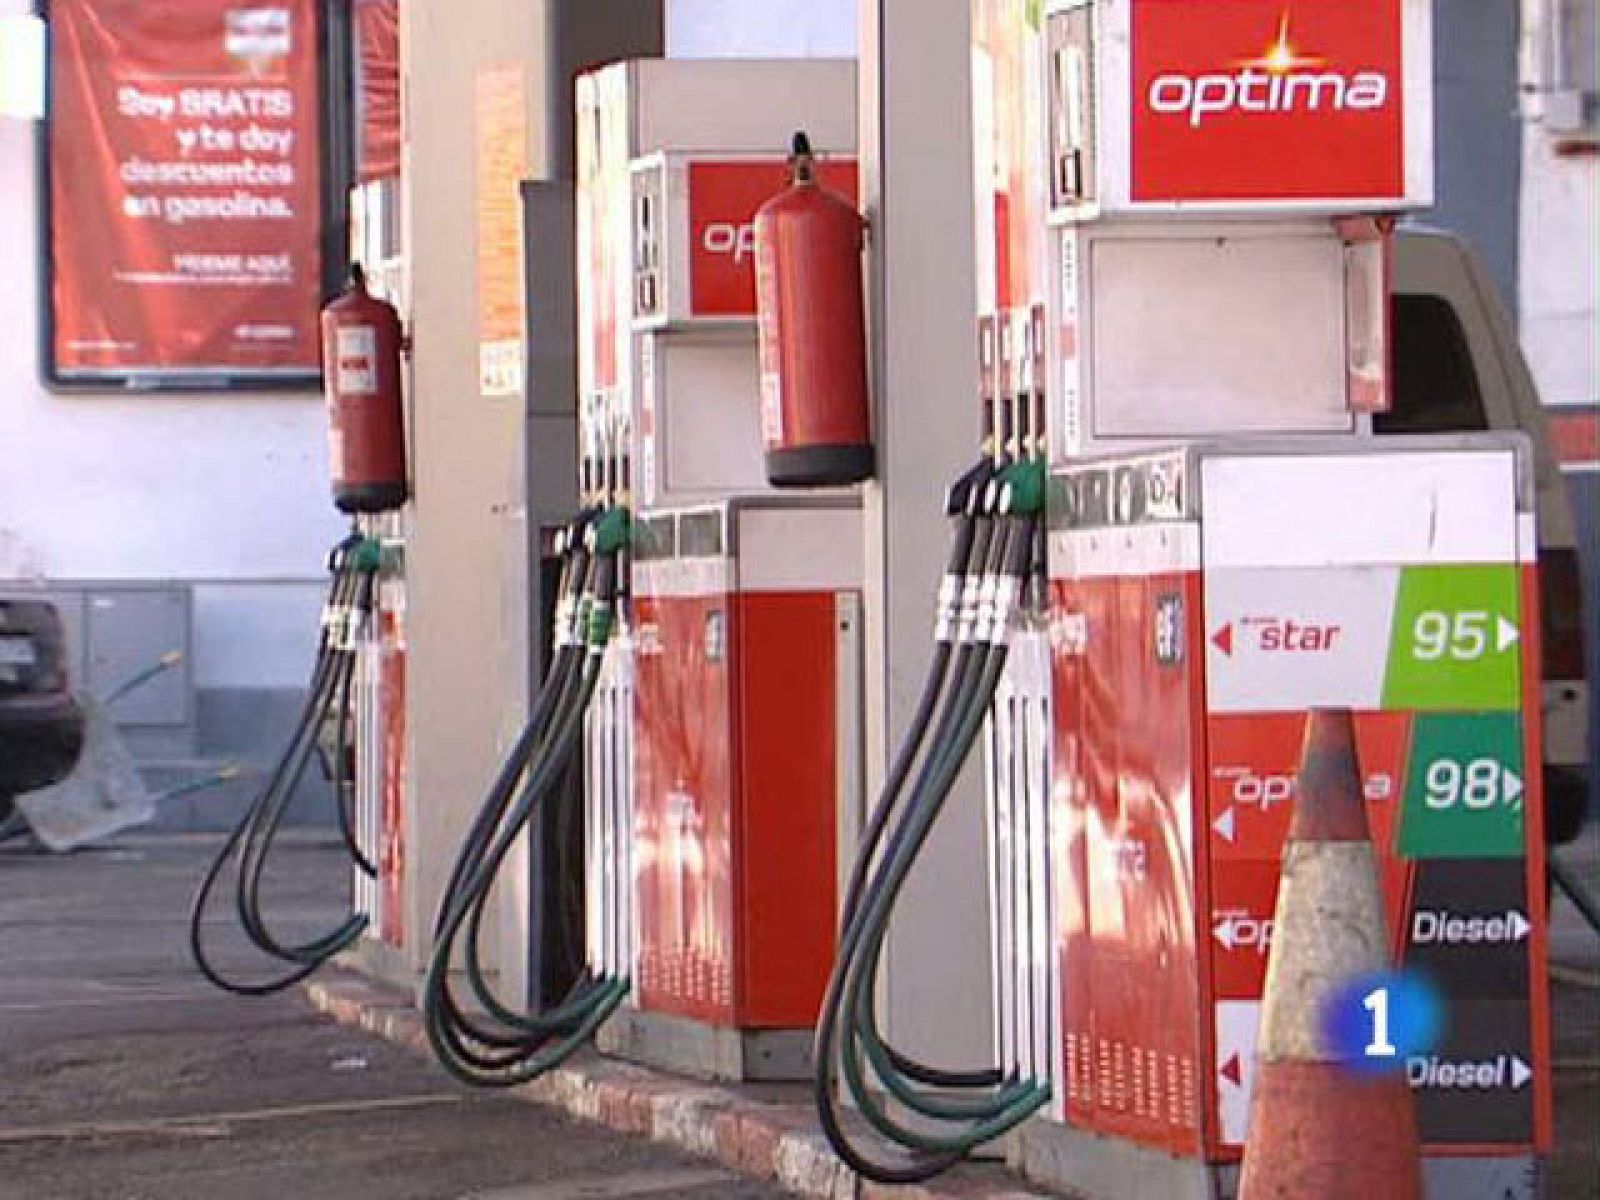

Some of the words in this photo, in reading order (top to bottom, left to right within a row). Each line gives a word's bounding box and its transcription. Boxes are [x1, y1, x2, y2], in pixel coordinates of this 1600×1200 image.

[117, 86, 175, 121] Soy
[179, 87, 293, 117] GRATIS
[1149, 68, 1387, 127] optima
[176, 126, 198, 157] y
[201, 122, 235, 151] te
[239, 123, 293, 156] doy
[1260, 619, 1341, 651] star
[1412, 611, 1489, 661] 95
[1425, 758, 1501, 810] 98
[1412, 911, 1516, 942] Diesel
[1407, 1055, 1505, 1087] Diesel
